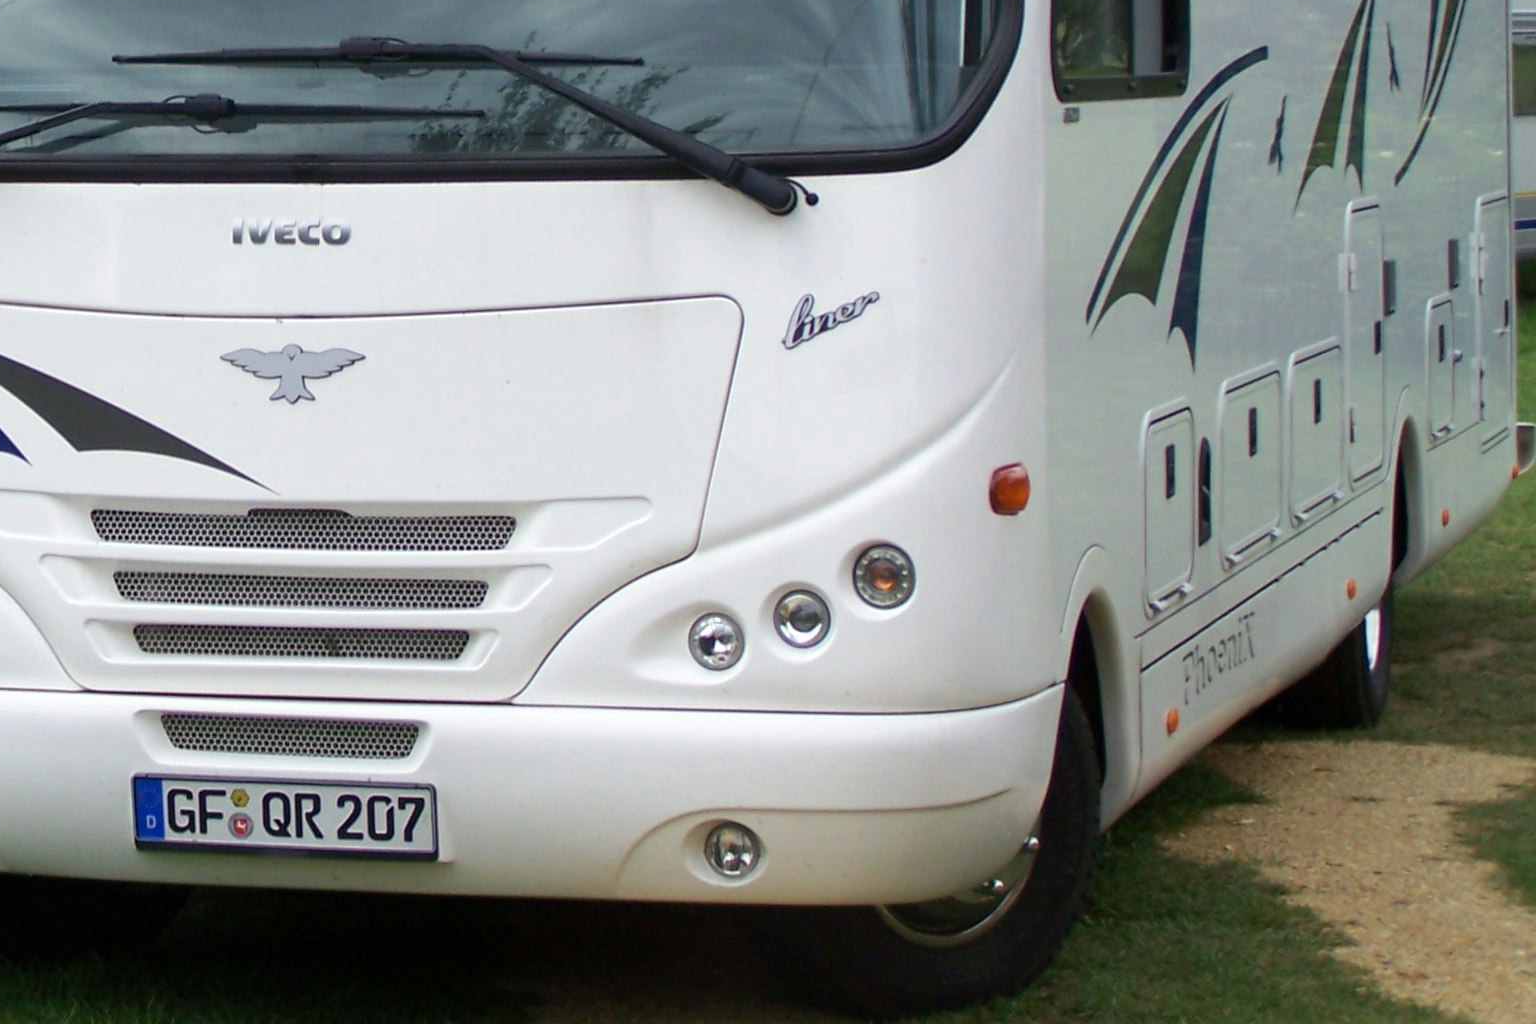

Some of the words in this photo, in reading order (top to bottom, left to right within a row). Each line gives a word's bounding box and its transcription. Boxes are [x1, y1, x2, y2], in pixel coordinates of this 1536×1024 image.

[232, 218, 352, 246] IVECO
[146, 814, 156, 829] D
[167, 788, 227, 835] GF
[262, 791, 324, 839] QR
[336, 794, 425, 843] 207
